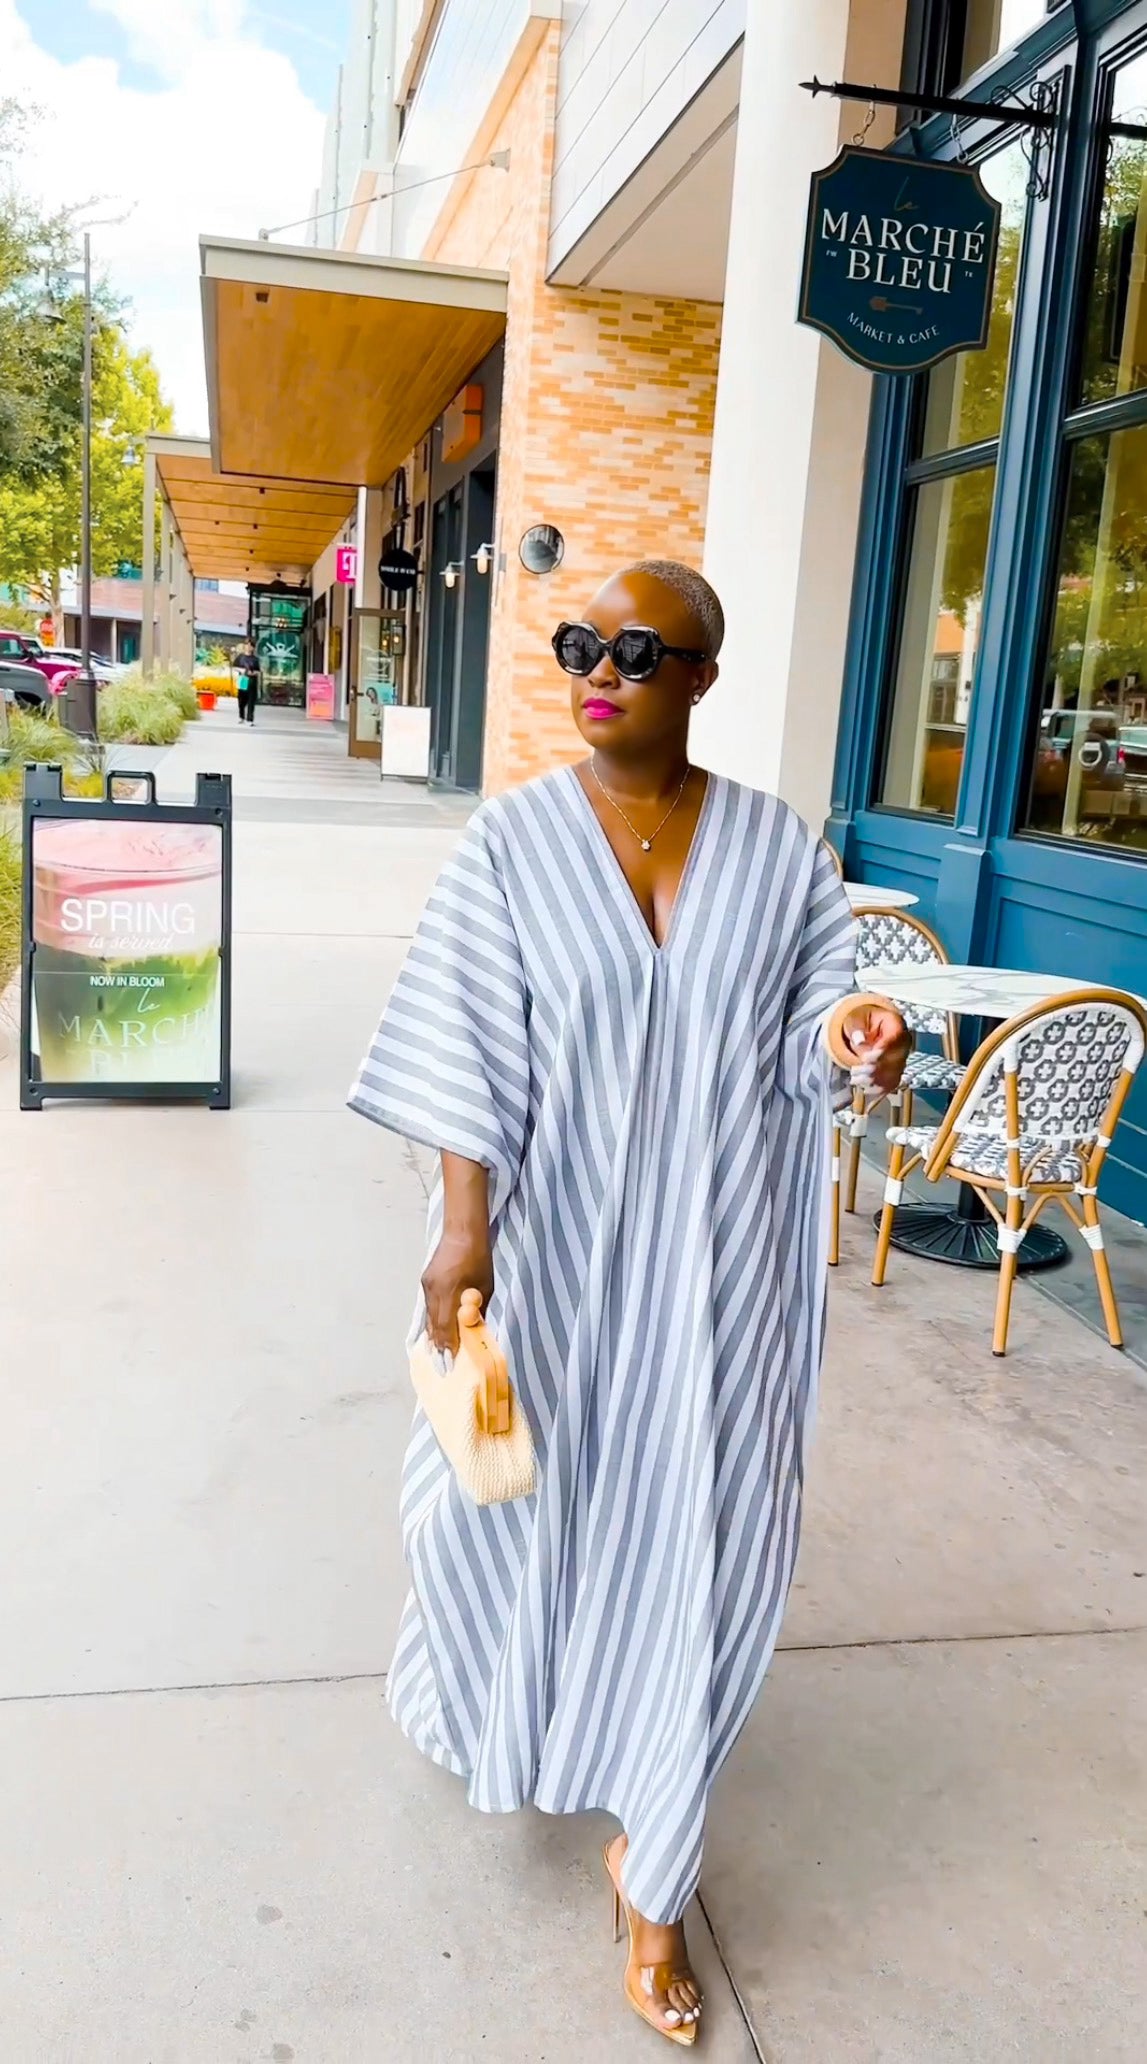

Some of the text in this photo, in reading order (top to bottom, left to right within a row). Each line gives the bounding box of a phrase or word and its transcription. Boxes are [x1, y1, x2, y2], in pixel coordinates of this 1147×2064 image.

[893, 176, 919, 211] le
[821, 208, 985, 264] MARCHÉ
[846, 248, 952, 294] BLEU
[847, 312, 940, 345] MARKET & CAFE
[60, 898, 195, 935] SPRING
[88, 931, 175, 951] is served
[90, 975, 165, 988] NOW IN BLOOM
[137, 987, 161, 1013] le
[58, 1006, 209, 1049] MARCH
